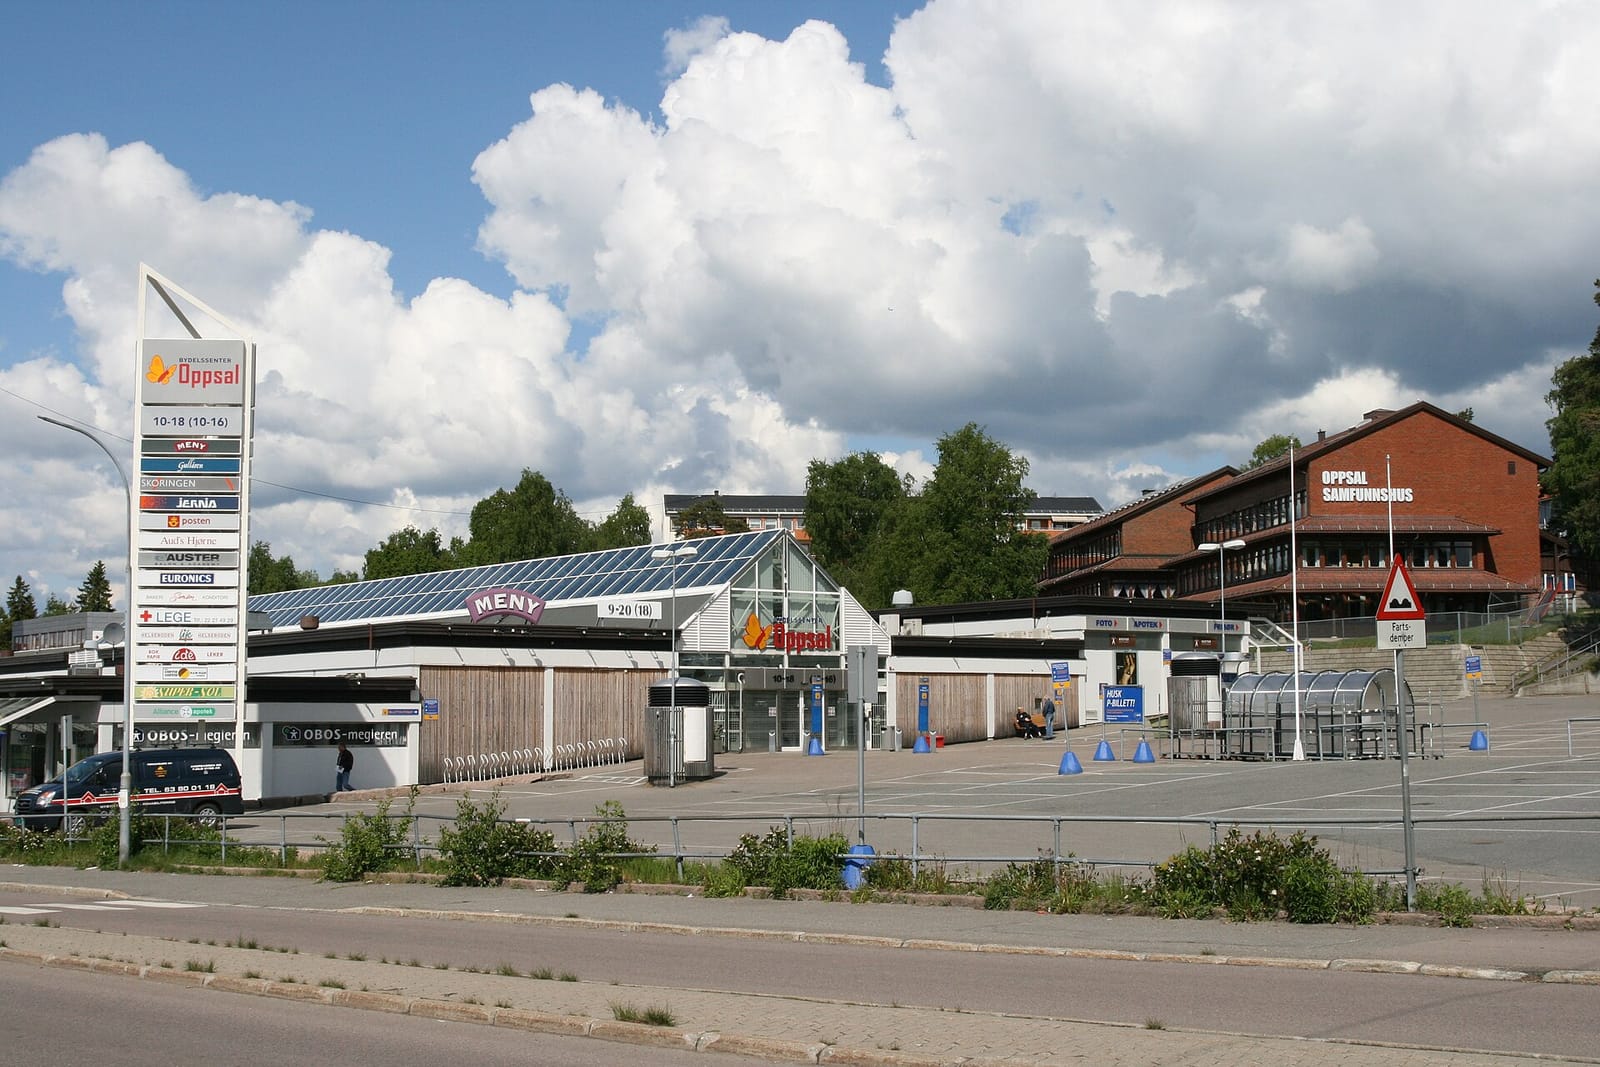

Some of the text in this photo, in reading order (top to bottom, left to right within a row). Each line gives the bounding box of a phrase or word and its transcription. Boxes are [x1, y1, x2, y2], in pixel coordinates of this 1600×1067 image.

[178, 363, 239, 388] Oppsal
[153, 417, 228, 428] 10-18 (10-16)
[176, 441, 206, 451] MENY
[1322, 471, 1368, 485] OPPSAL
[1322, 488, 1413, 502] SAMFUNNSHUS
[182, 517, 211, 526] posten
[166, 553, 220, 562] AUSTER
[161, 574, 212, 583] EURONICS
[473, 593, 540, 616] MENY
[634, 604, 653, 617] (18)
[156, 612, 192, 623] LEGE
[1392, 622, 1411, 631] Farts-
[773, 623, 831, 654] Oppsal
[1390, 634, 1414, 643] demper
[810, 675, 836, 684] (-16)
[1107, 690, 1122, 698] HUSK
[147, 729, 250, 743] OBOS-eglern
[304, 728, 398, 743] OBOS-megleren
